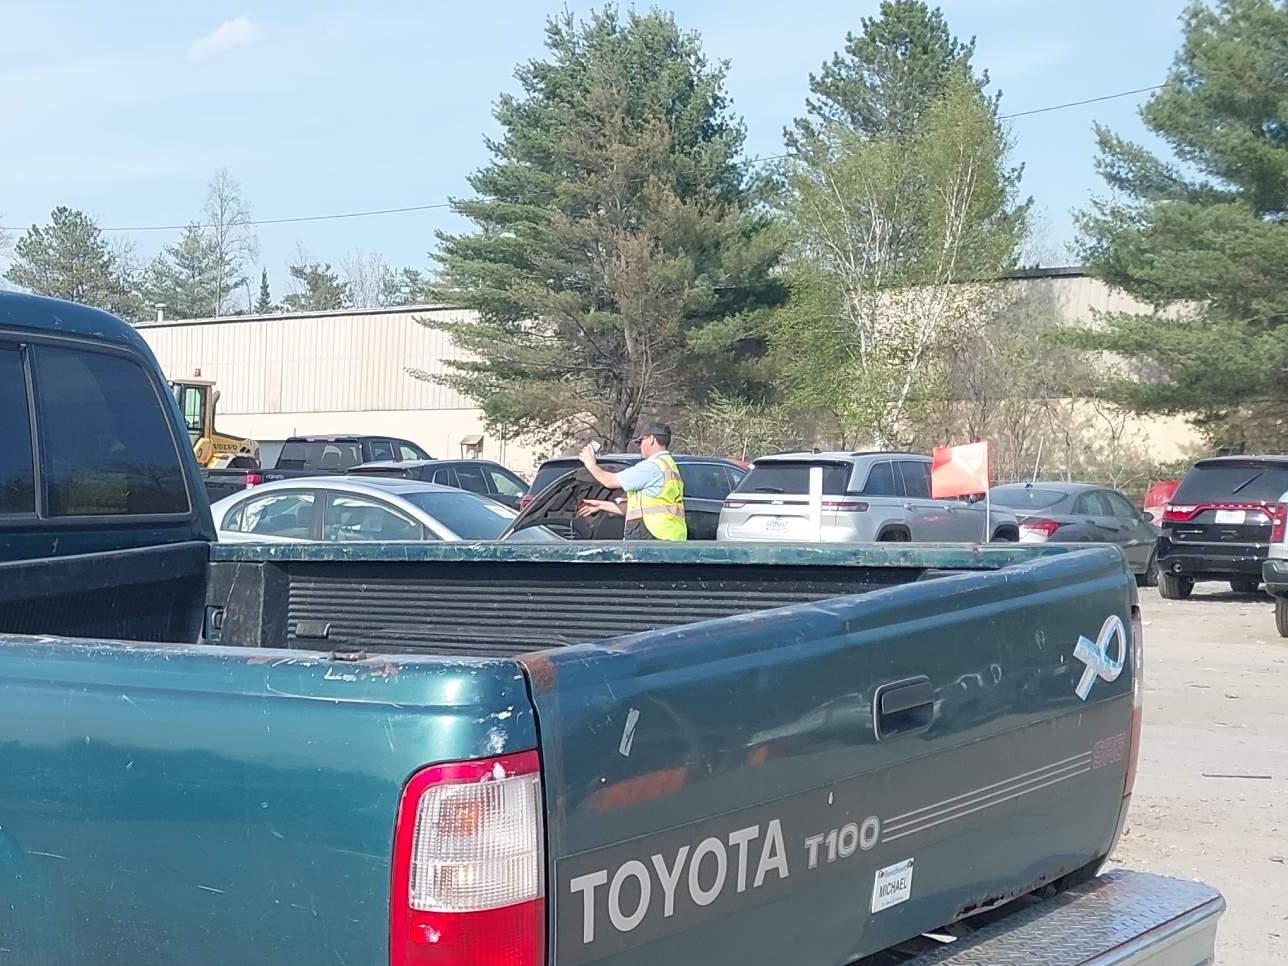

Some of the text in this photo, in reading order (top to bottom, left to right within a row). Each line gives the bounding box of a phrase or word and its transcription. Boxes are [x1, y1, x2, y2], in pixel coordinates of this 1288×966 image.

[570, 816, 882, 944] TOYOTA T100
[879, 877, 907, 897] MICHAEL
